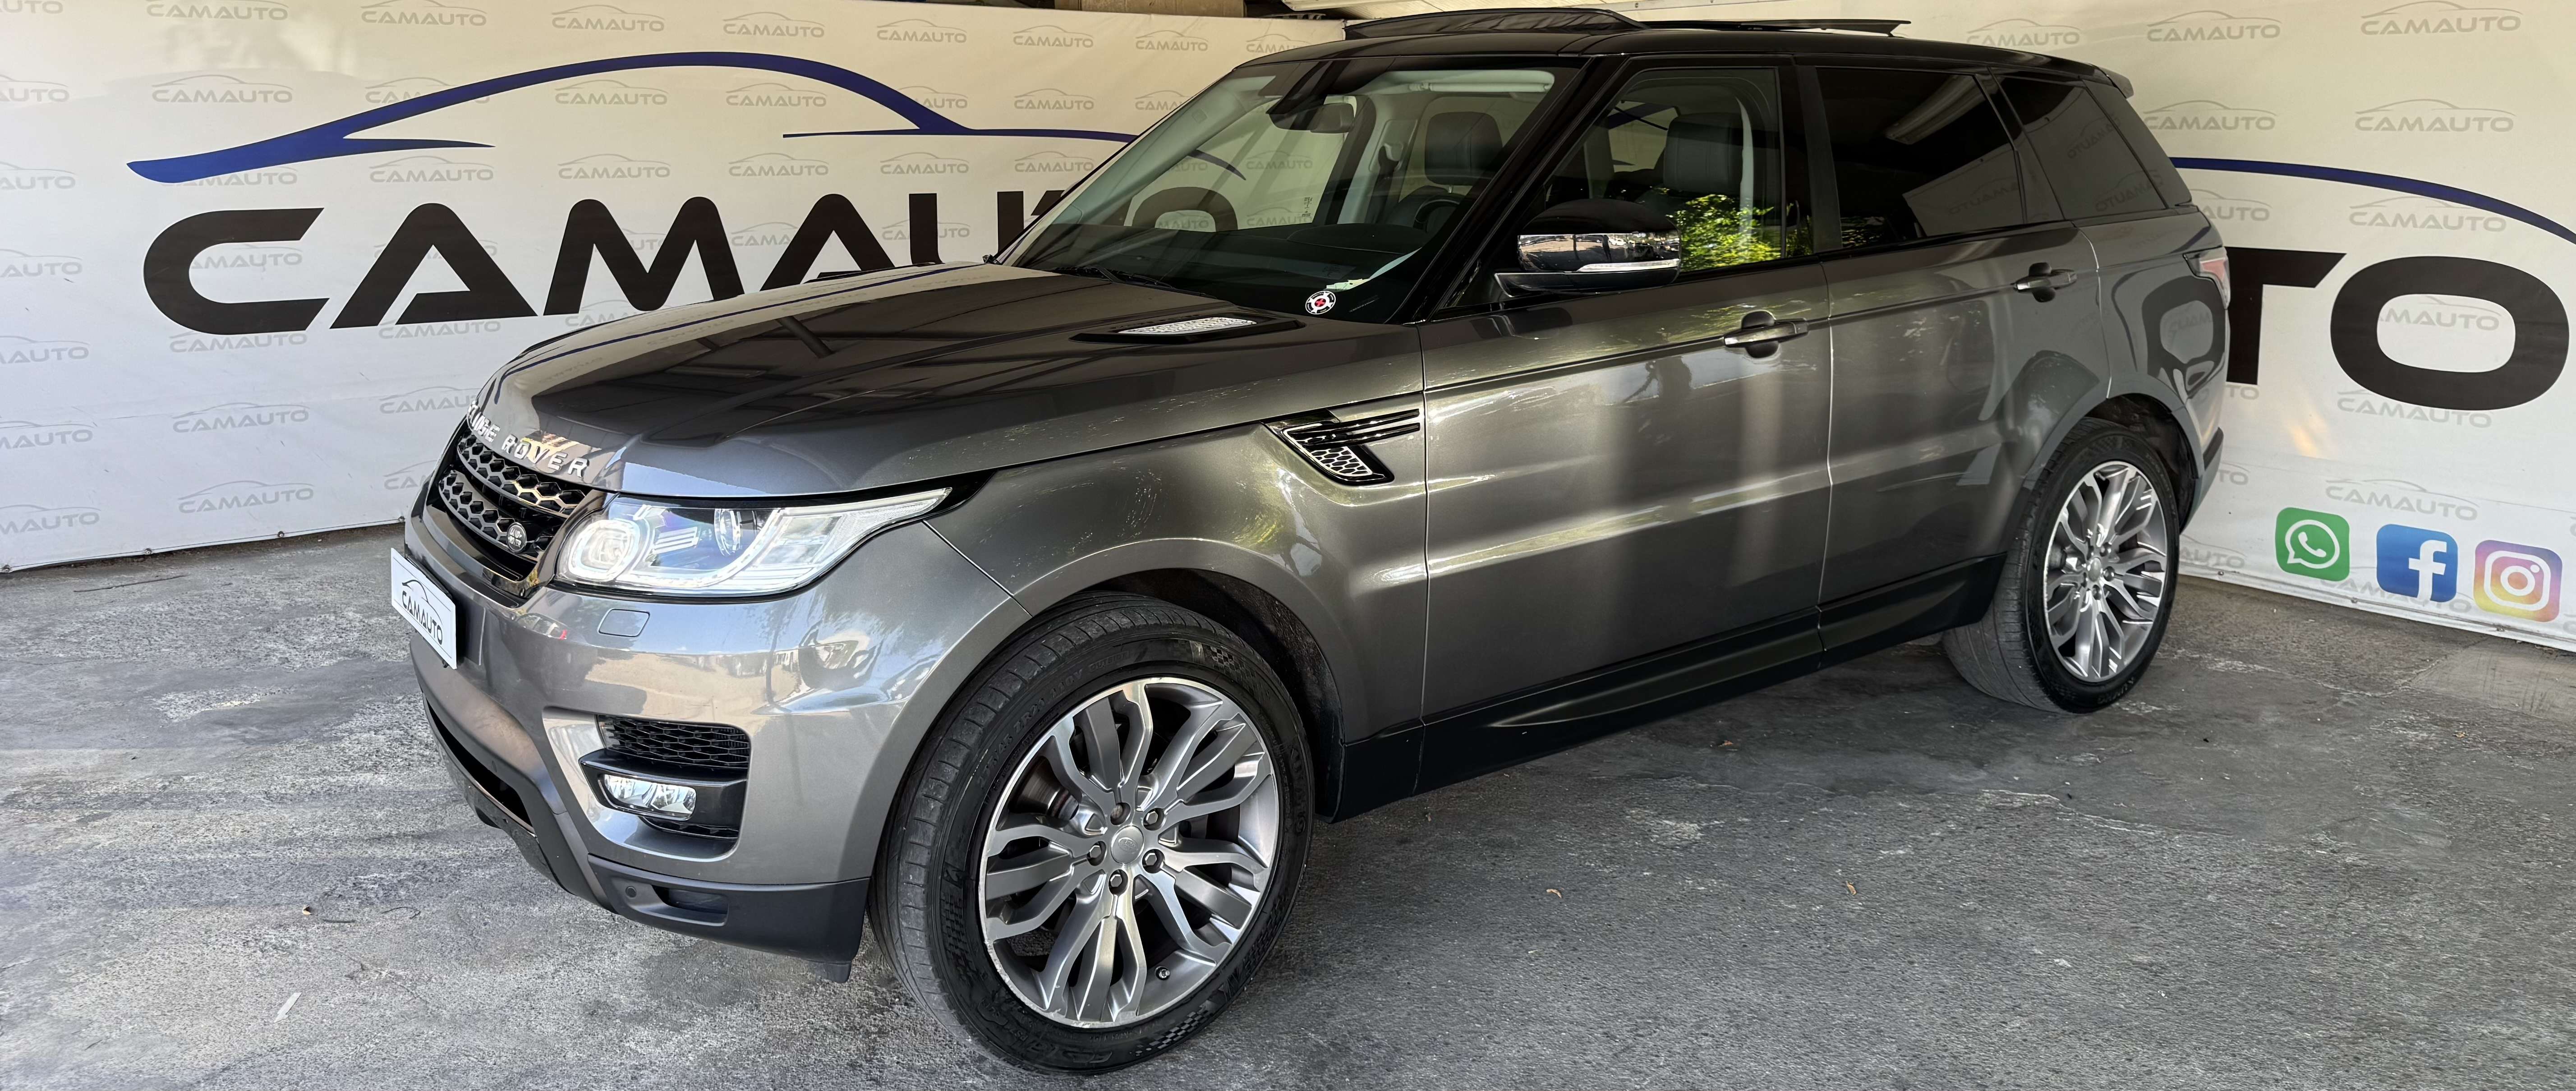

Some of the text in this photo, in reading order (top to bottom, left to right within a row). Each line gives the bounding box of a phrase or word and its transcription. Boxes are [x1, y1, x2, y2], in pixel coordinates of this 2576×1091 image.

[147, 4, 289, 21] CAMAUTO
[361, 10, 487, 26] CAMAUTO
[552, 17, 665, 32] CAMAUTO
[723, 23, 825, 38] CAMAUTO
[2361, 16, 2521, 35] CAMAUTO
[877, 29, 967, 44] CAMAUTO
[2147, 24, 2281, 41] CAMAUTO
[1013, 35, 1094, 48] CAMAUTO
[1135, 39, 1209, 51] CAMAUTO
[152, 89, 293, 103] CAMAUTO
[555, 92, 668, 106] CAMAUTO
[726, 95, 827, 107] CAMAUTO
[922, 97, 968, 109] AUTO
[1014, 98, 1095, 110] CAMAUTO
[2144, 116, 2276, 130] CAMAUTO
[2355, 116, 2514, 132] CAMAUTO
[728, 165, 829, 177] CAMAUTO
[880, 163, 969, 175] CAMAUTO
[1015, 161, 1094, 173] CAMAUTO
[1246, 160, 1313, 170] CAMAUTO
[370, 168, 494, 183] CAMAUTO
[558, 166, 671, 180] CAMAUTO
[0, 176, 76, 190] AUTO
[2202, 206, 2270, 221] AUTO
[2349, 212, 2507, 232] CAMAUTO
[731, 234, 792, 247] CAMA
[0, 262, 83, 277] AUTO
[378, 320, 501, 339] CAMAUTO
[169, 332, 307, 353] CAMAUTO
[2337, 397, 2492, 428] CAMAUTO
[172, 410, 309, 433] CAMAUTO
[501, 434, 589, 478] ROVER
[178, 487, 314, 514] CAMAUTO
[2325, 485, 2479, 521] CAMAUTO
[402, 590, 443, 645] CAMAUTO
